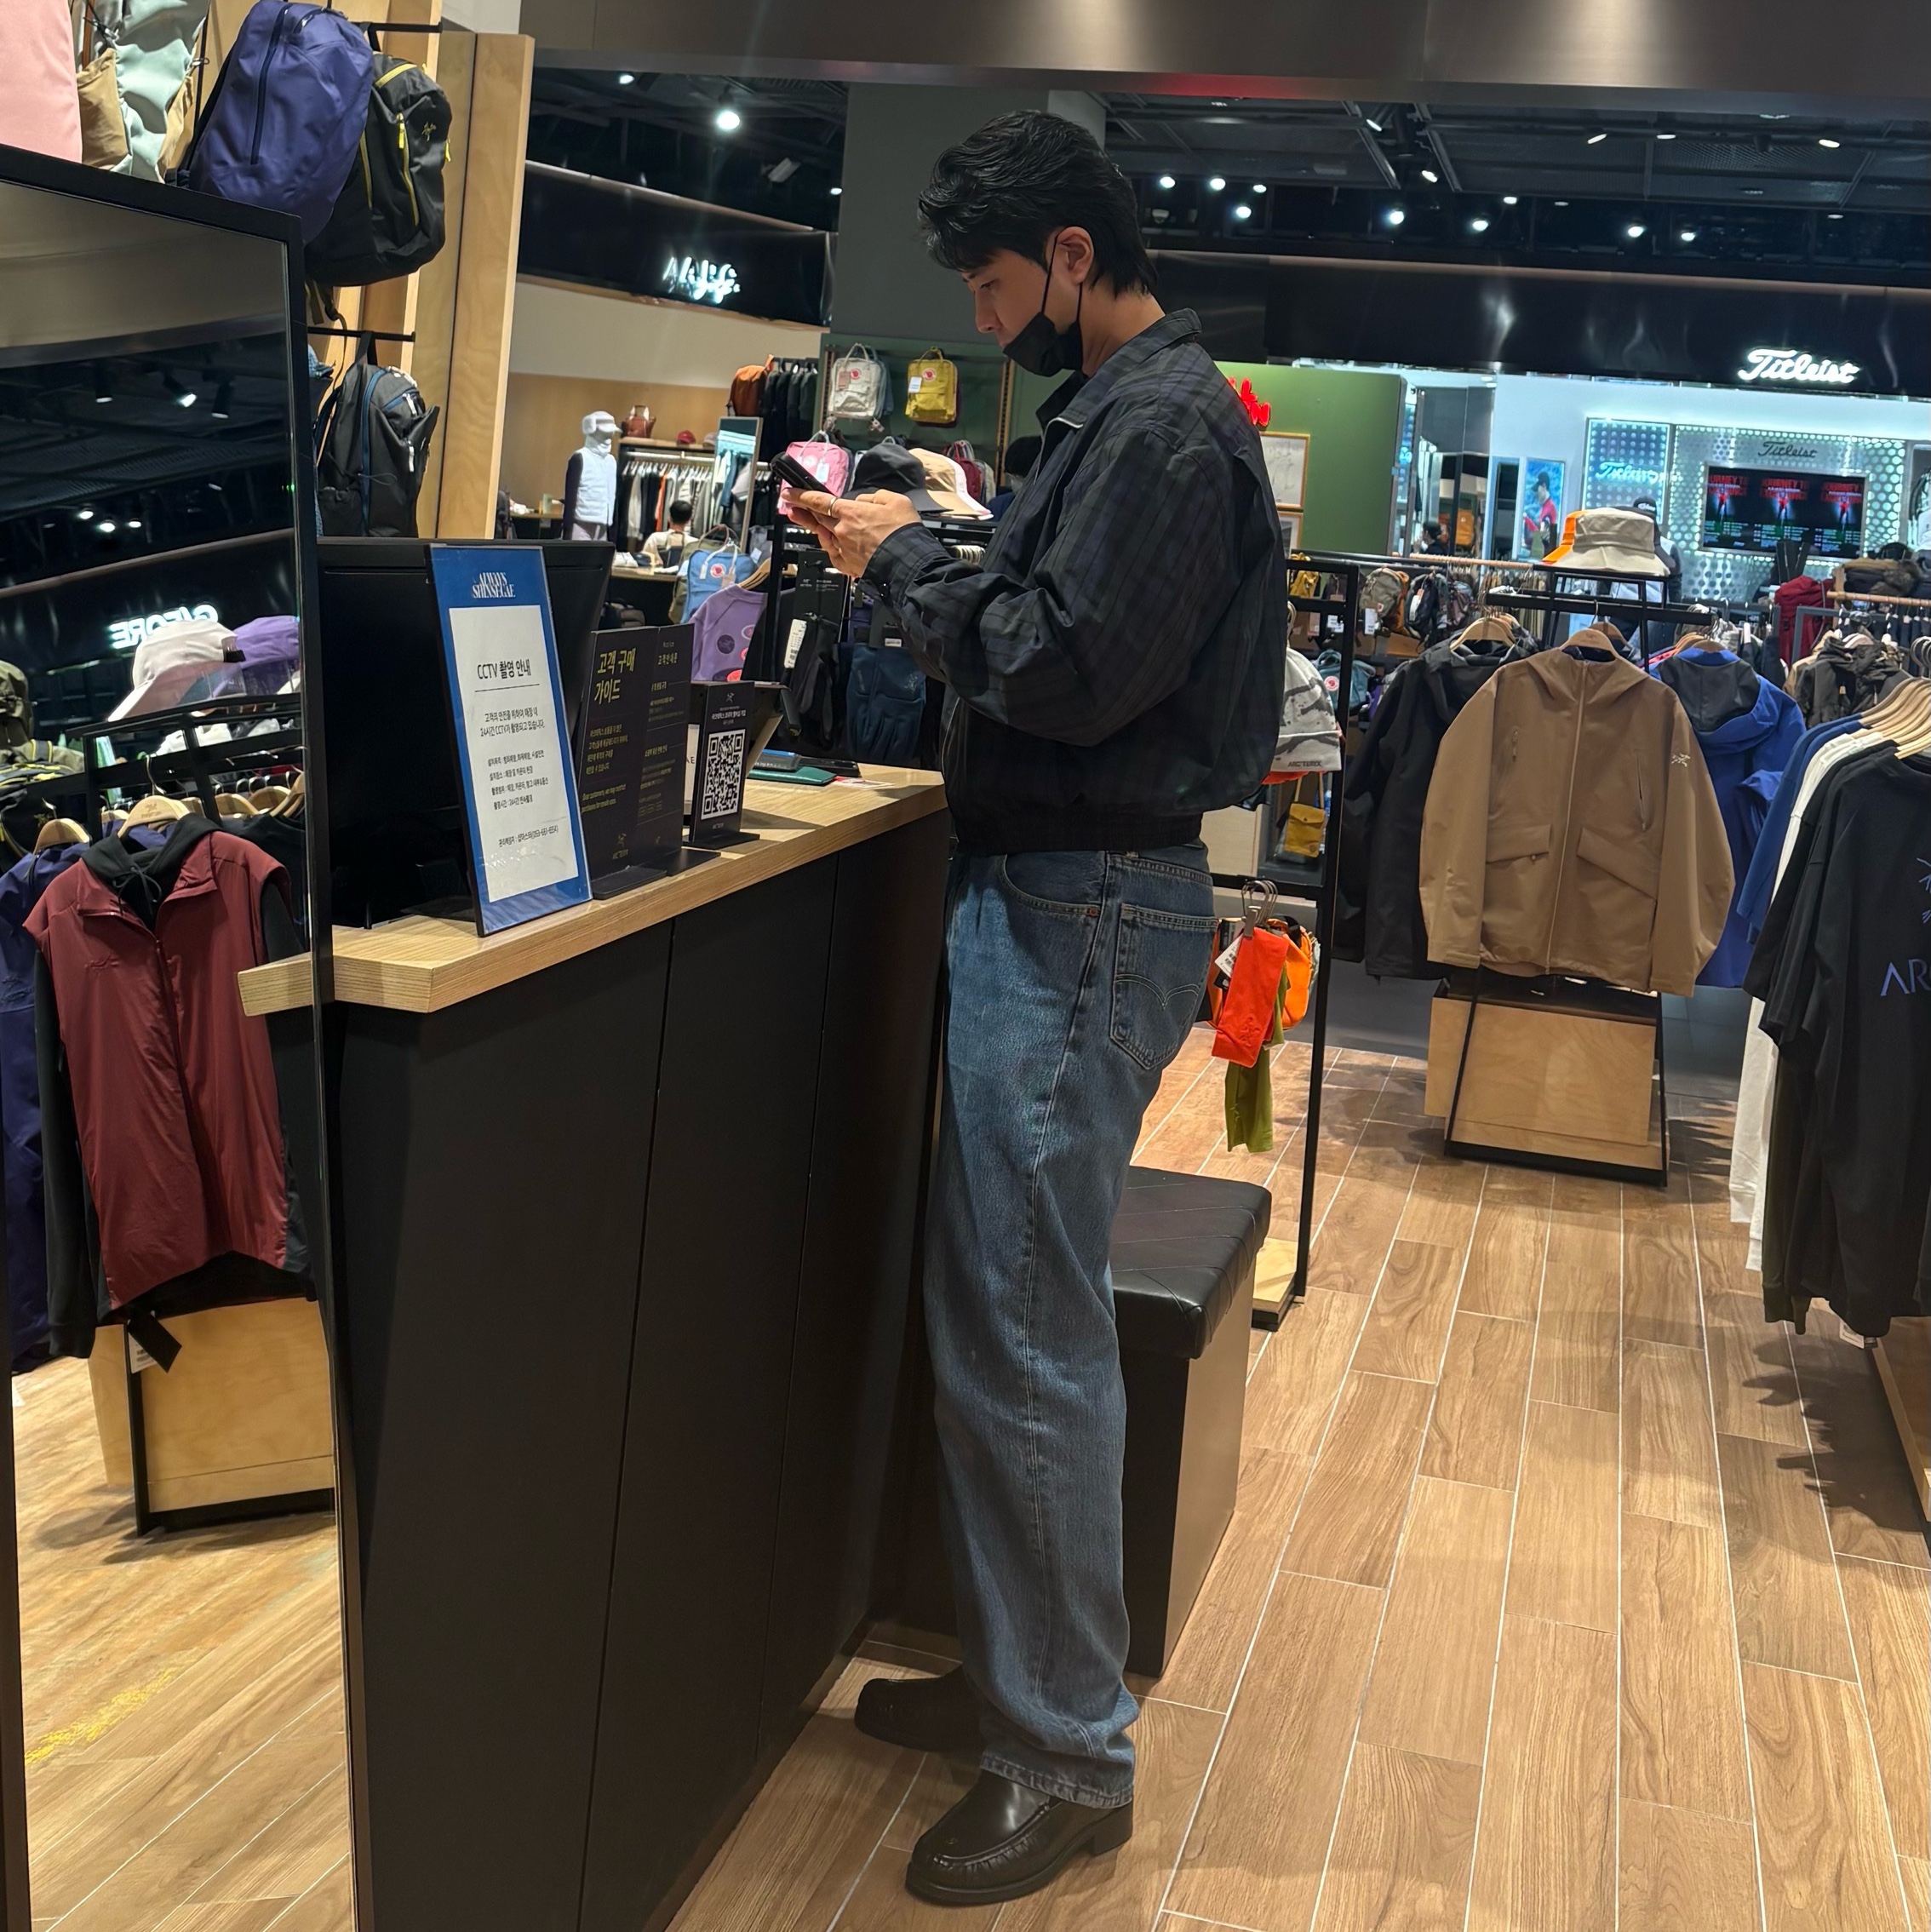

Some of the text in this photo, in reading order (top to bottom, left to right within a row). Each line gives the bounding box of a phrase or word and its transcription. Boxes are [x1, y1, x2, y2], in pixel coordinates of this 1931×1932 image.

[1738, 347, 1860, 384] Titleist
[1757, 440, 1818, 459] Titleist
[478, 571, 507, 585] ALWAYS
[472, 583, 516, 599] SHINSEGAE
[477, 658, 532, 679] CCTV 촬영 안내
[597, 647, 637, 675] 고객 구매
[594, 679, 621, 705] 가이드
